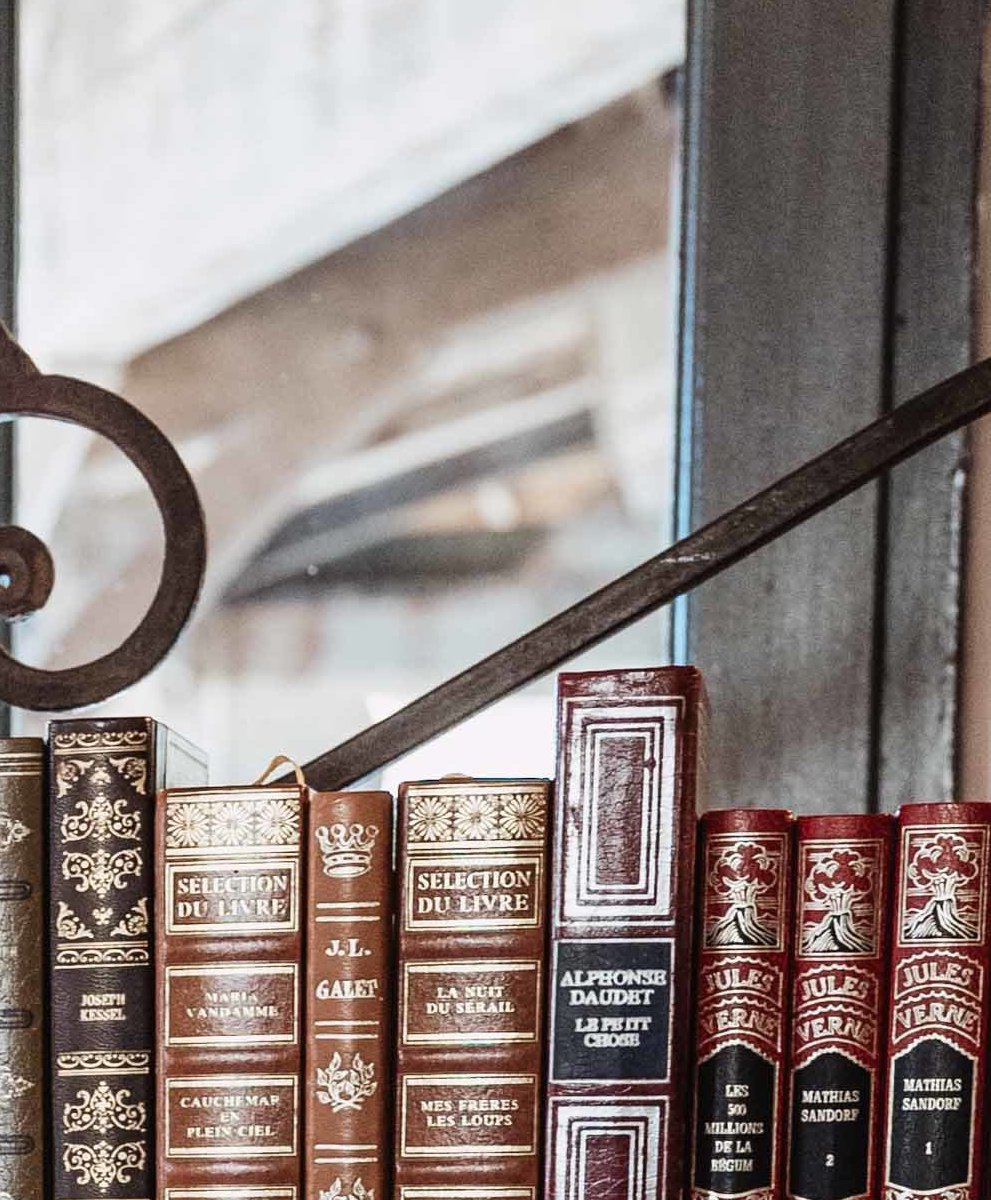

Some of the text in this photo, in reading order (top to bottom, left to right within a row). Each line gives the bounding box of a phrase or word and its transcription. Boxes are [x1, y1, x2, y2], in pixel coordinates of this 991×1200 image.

[177, 898, 287, 918] DU LIVRE
[417, 894, 529, 914] DU LIVRE
[560, 969, 667, 987] ALPHONSE
[706, 968, 774, 993] JULES
[902, 961, 974, 988] JULES
[315, 979, 379, 1000] GALET
[437, 986, 505, 999] LA NUIT
[801, 975, 870, 1001] JULES
[81, 993, 126, 1006] JOSEPH
[205, 991, 257, 1003] MARIA
[568, 988, 655, 1006] DAUDET
[79, 1008, 127, 1021] KESSEL
[186, 1006, 279, 1018] VANDAMME
[426, 1003, 449, 1015] DU
[574, 1016, 652, 1032] LE PETIT
[703, 1007, 778, 1038] VERNE
[896, 1002, 979, 1032] VERNE
[796, 1015, 875, 1045] VERNE
[583, 1032, 640, 1048] CHOSE
[725, 1085, 749, 1098] LES
[903, 1078, 963, 1092] MATHIAS
[180, 1095, 280, 1109] CAUCHEMAR
[802, 1089, 860, 1103] MATHIAS
[421, 1100, 452, 1112] MES
[727, 1104, 747, 1117] 500
[902, 1097, 962, 1111] SANDORF
[219, 1112, 241, 1123] EN
[427, 1114, 513, 1127] LES LOUPS
[801, 1109, 860, 1123] SANDORF
[705, 1122, 764, 1135] MILLIONS
[715, 1140, 752, 1153] DE LA
[924, 1141, 934, 1155] 1
[825, 1154, 836, 1167] 2
